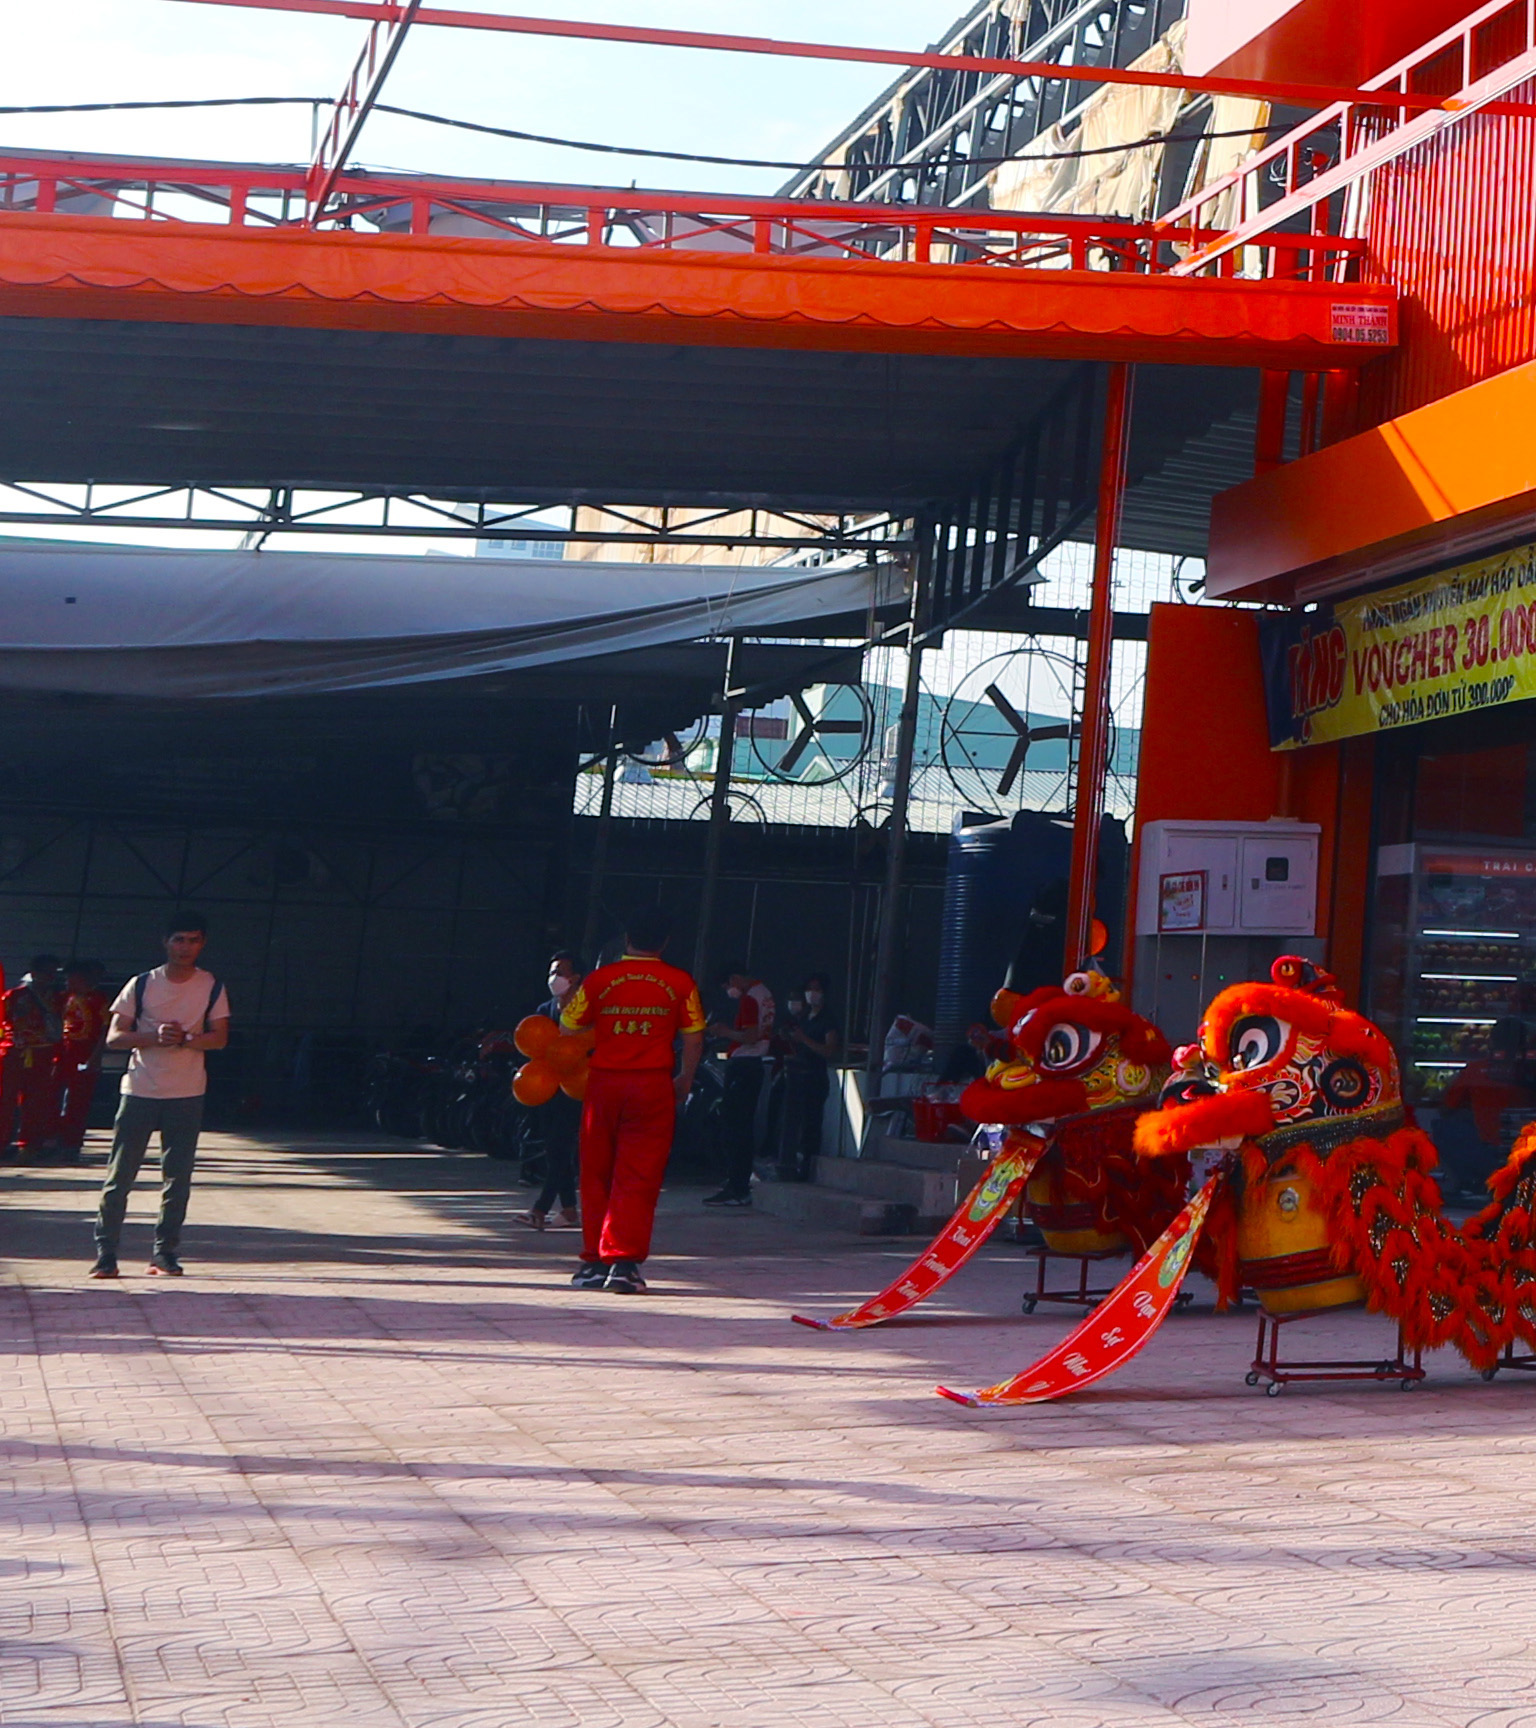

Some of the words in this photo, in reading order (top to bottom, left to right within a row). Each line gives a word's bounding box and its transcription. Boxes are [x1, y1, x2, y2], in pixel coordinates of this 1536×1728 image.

[1353, 623, 1459, 696] VOUCHER
[1378, 700, 1401, 728] CHO
[1402, 689, 1425, 723] HÓA
